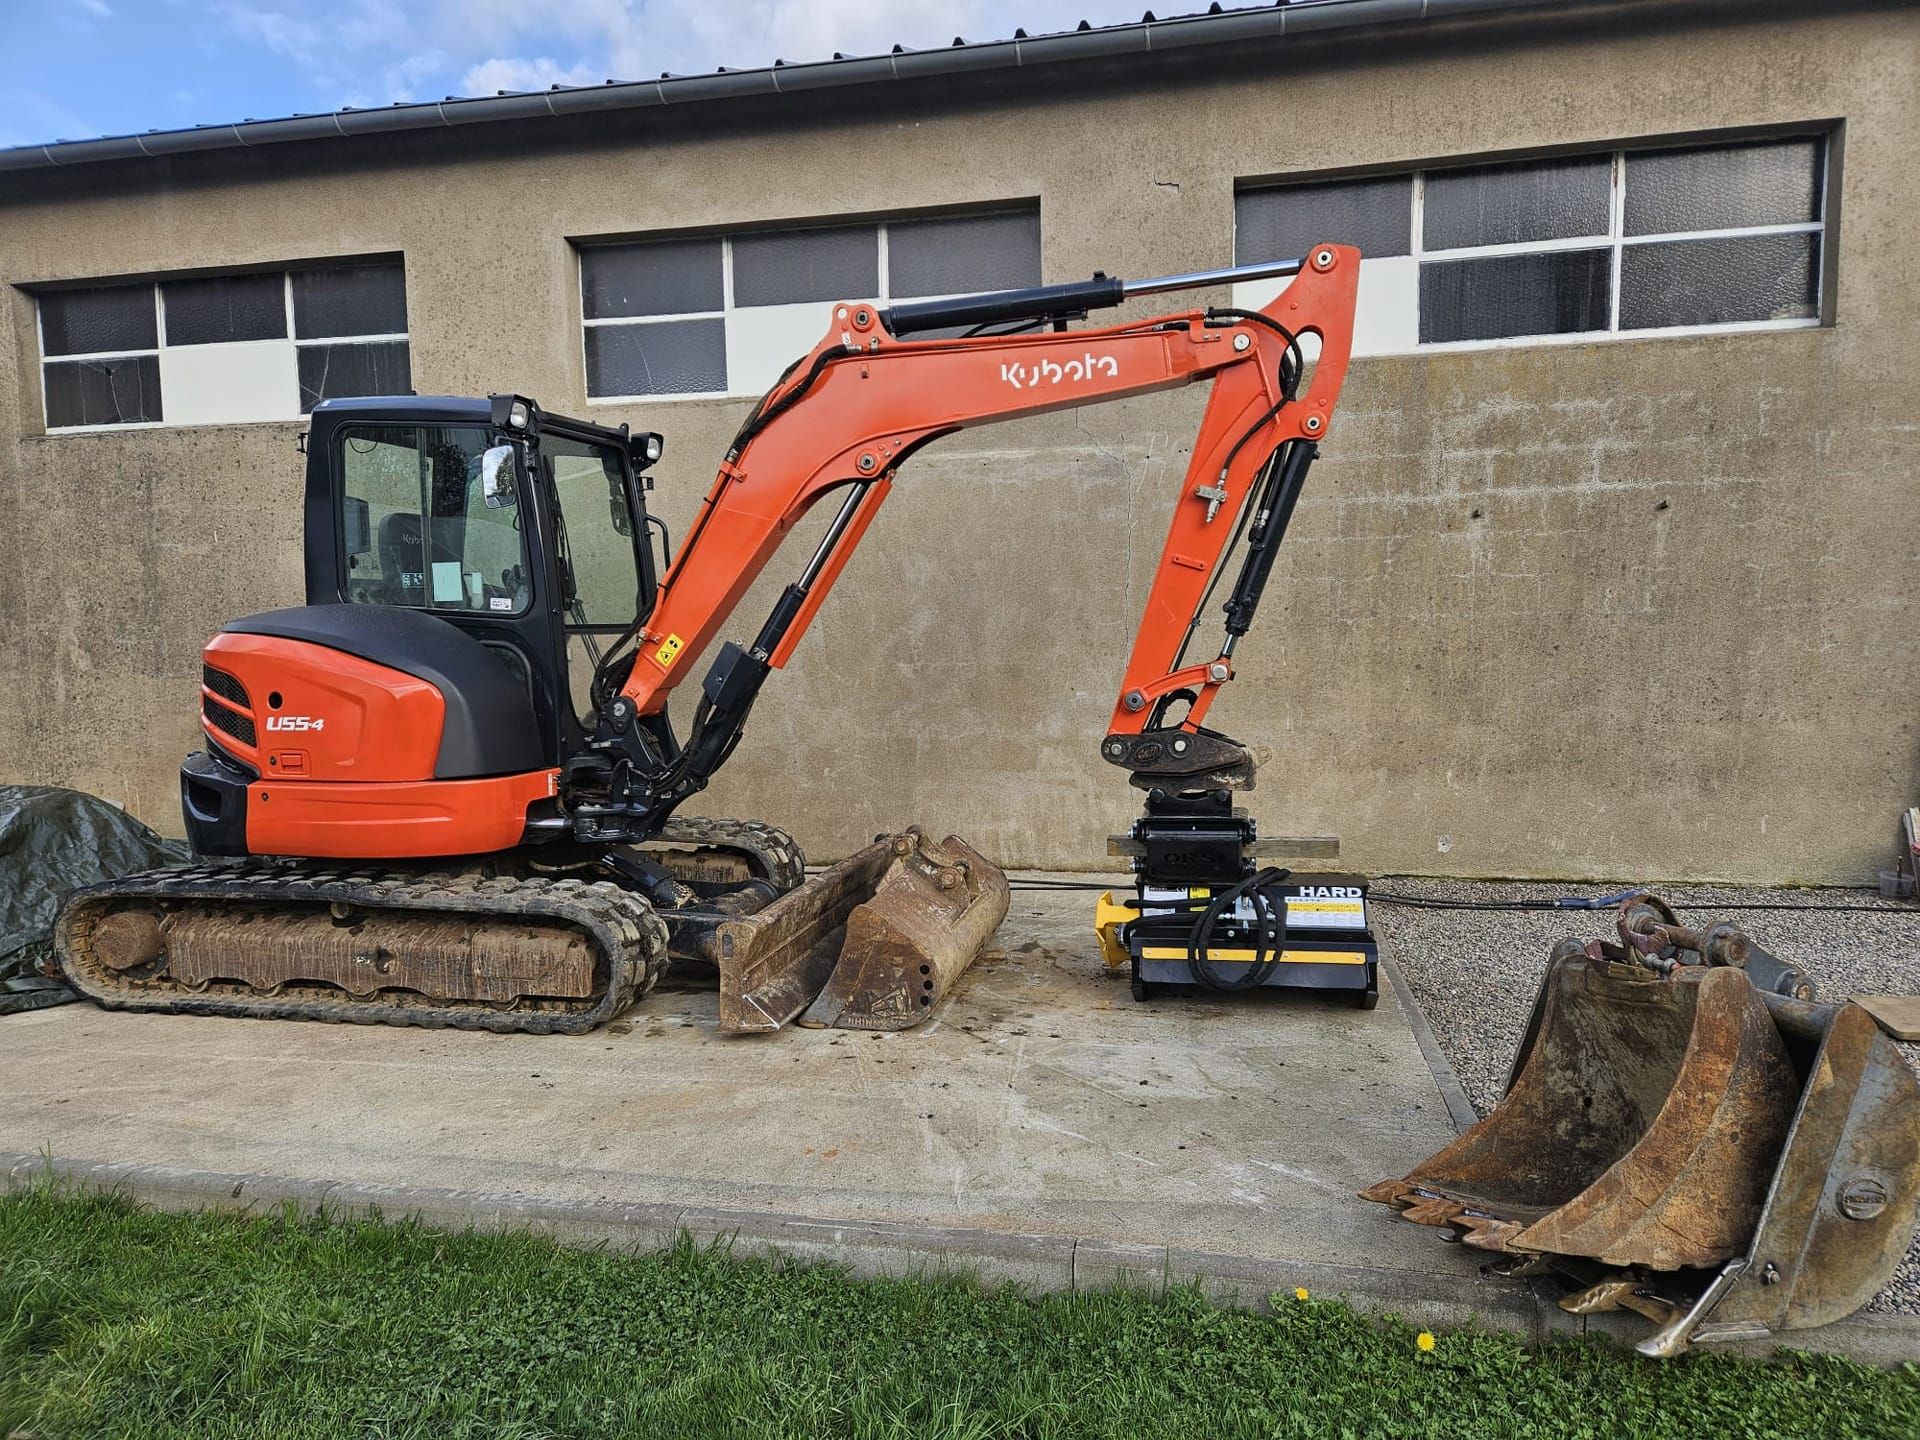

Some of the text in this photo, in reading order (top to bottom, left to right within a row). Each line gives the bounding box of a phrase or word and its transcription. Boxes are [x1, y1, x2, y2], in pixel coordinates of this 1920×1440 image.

[1001, 353, 1118, 388] Kubota
[266, 716, 324, 731] U55-4
[1300, 886, 1363, 898] HARD
